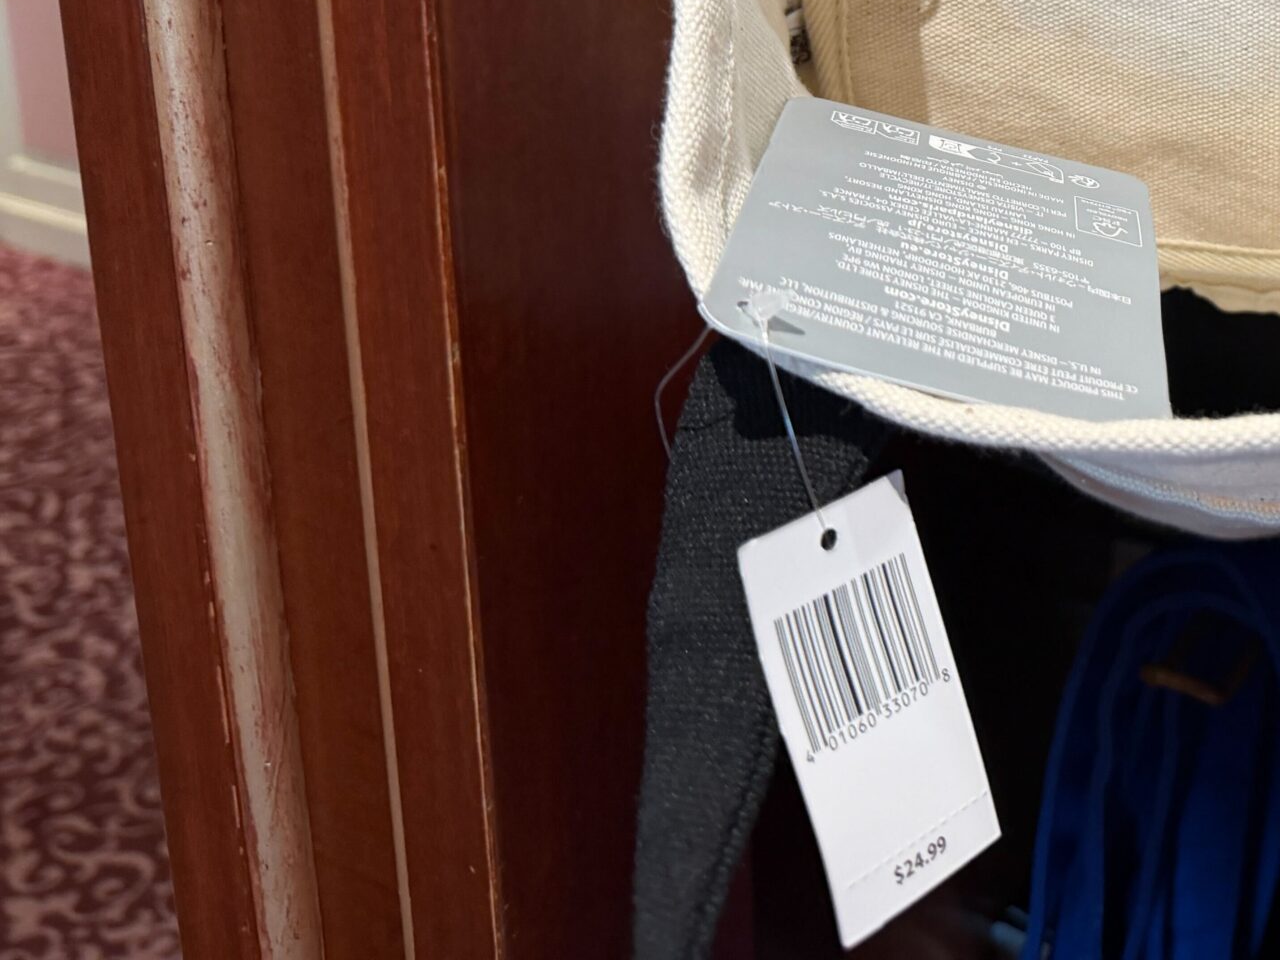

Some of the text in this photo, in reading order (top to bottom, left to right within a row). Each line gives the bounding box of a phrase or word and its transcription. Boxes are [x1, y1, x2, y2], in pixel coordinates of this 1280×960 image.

[897, 183, 923, 194] KONG
[942, 176, 974, 188] DISNEY
[834, 187, 870, 201] FRANCE
[883, 186, 943, 205] DISNEYLAND
[924, 189, 951, 200] HONG
[888, 193, 1032, 235] disneylandparis.com
[890, 200, 919, 213] CEDEX
[944, 200, 971, 212] KONG
[973, 207, 999, 219] HONG
[990, 206, 1027, 220] LANTAU
[894, 209, 929, 222] DISNEY
[931, 217, 957, 229] EURO
[1010, 217, 1036, 228] KONG
[907, 219, 1008, 253] Disneystore.jp
[968, 226, 1004, 242] FRANCE
[1037, 223, 1064, 235] HONG
[1029, 243, 1060, 257] PARKS
[1049, 242, 1066, 252] 100
[835, 259, 858, 273] LTD.
[842, 253, 861, 265] 9PE
[863, 259, 880, 271] W6
[864, 249, 907, 268] TRADING
[900, 241, 1008, 280] DisneyStore.eu
[1060, 252, 1094, 267] DISNEY
[828, 232, 1073, 308] POSTBUS 406, 2130 AK HOOFDDORP, NETHERLANDS
[859, 266, 891, 282] STORE
[882, 264, 924, 283] LONDON
[910, 262, 946, 279] DISNEY
[779, 276, 799, 290] LLC
[892, 276, 929, 294] DISNEY
[927, 276, 964, 295] STREET,
[958, 276, 990, 292] UNION
[802, 282, 878, 313] DISTRIBUTION,
[931, 287, 949, 300] THE
[966, 289, 1013, 310] CAROLINE
[992, 286, 1043, 308] EUROPEAN
[884, 286, 1010, 332] DisneyStore.com
[962, 297, 1009, 318] KINGDOM
[1015, 304, 1048, 320] QUEEN
[1044, 302, 1055, 312] IN
[873, 317, 899, 333] PAYS
[891, 310, 943, 333] SOURCING
[894, 300, 997, 337] BURBANK, CA 91521
[1011, 312, 1047, 329] UNITED
[909, 328, 936, 344] SUR
[1048, 323, 1060, 333] IN
[866, 327, 920, 349] RELEVANT
[946, 326, 1019, 354] MERCHANDISE
[922, 343, 941, 356] THE
[943, 349, 955, 359] IN
[1020, 348, 1058, 365] DISNEY
[958, 353, 1007, 373] SUPPLIED
[1024, 360, 1049, 375] ÊTRE
[1089, 366, 1101, 375] IN
[1010, 367, 1023, 378] BE
[1024, 371, 1049, 384] MAY
[1051, 368, 1077, 381] PEUT
[1051, 378, 1099, 395] PRODUCT
[1079, 374, 1123, 391] PRODUIT
[1125, 384, 1138, 394] CE
[1100, 388, 1124, 400] THIS
[827, 712, 877, 751] 01060
[882, 681, 929, 719] 33070
[941, 668, 951, 683] 8
[893, 835, 948, 885] $24.99
